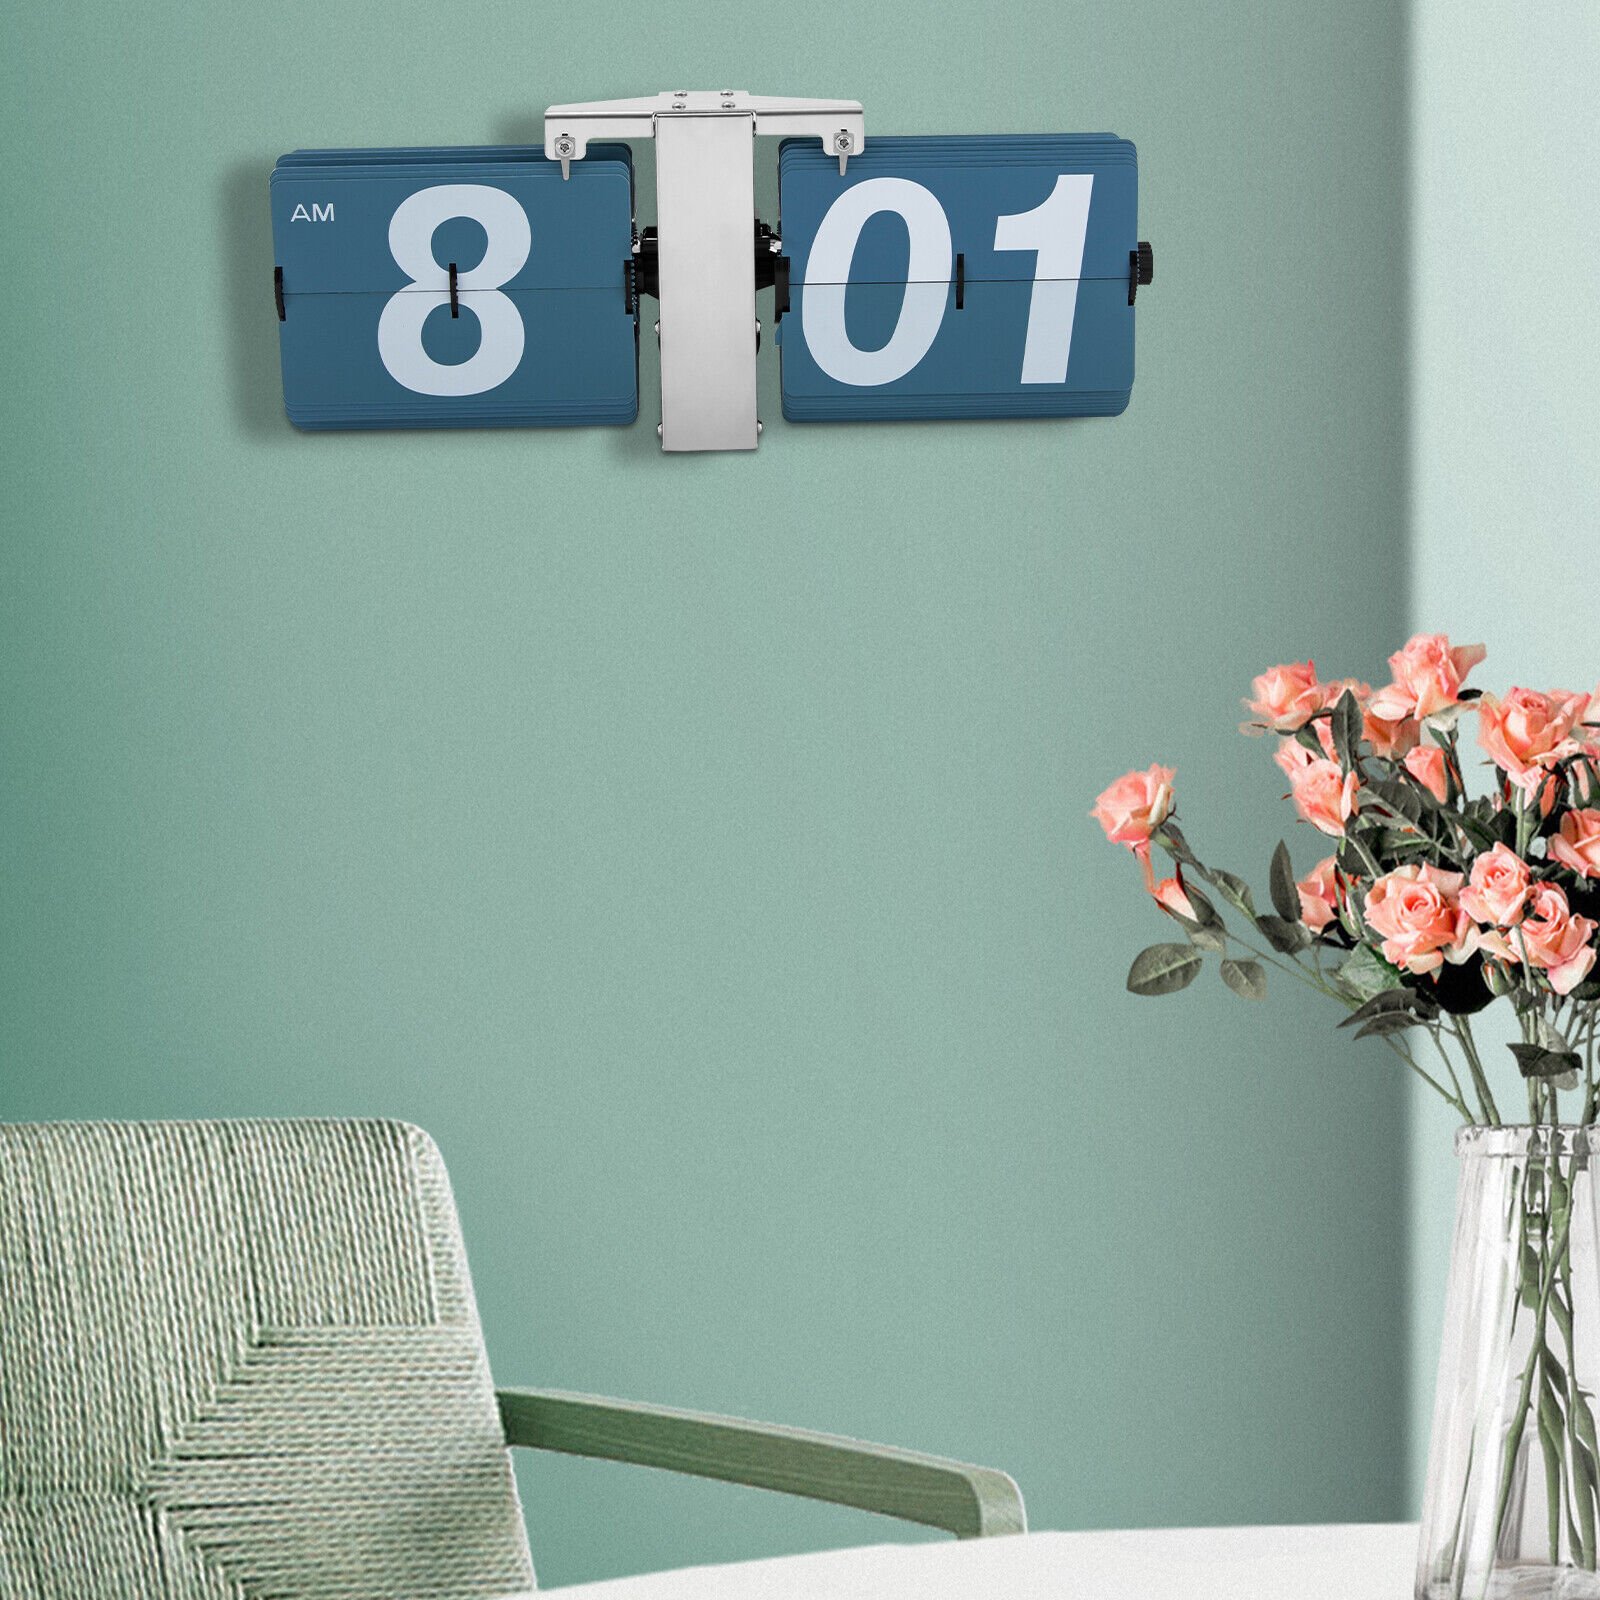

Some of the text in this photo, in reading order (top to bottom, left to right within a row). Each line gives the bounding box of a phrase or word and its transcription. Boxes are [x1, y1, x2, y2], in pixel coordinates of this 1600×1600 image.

[290, 203, 335, 222] AM
[378, 184, 532, 397] 8
[802, 174, 1095, 387] 01
